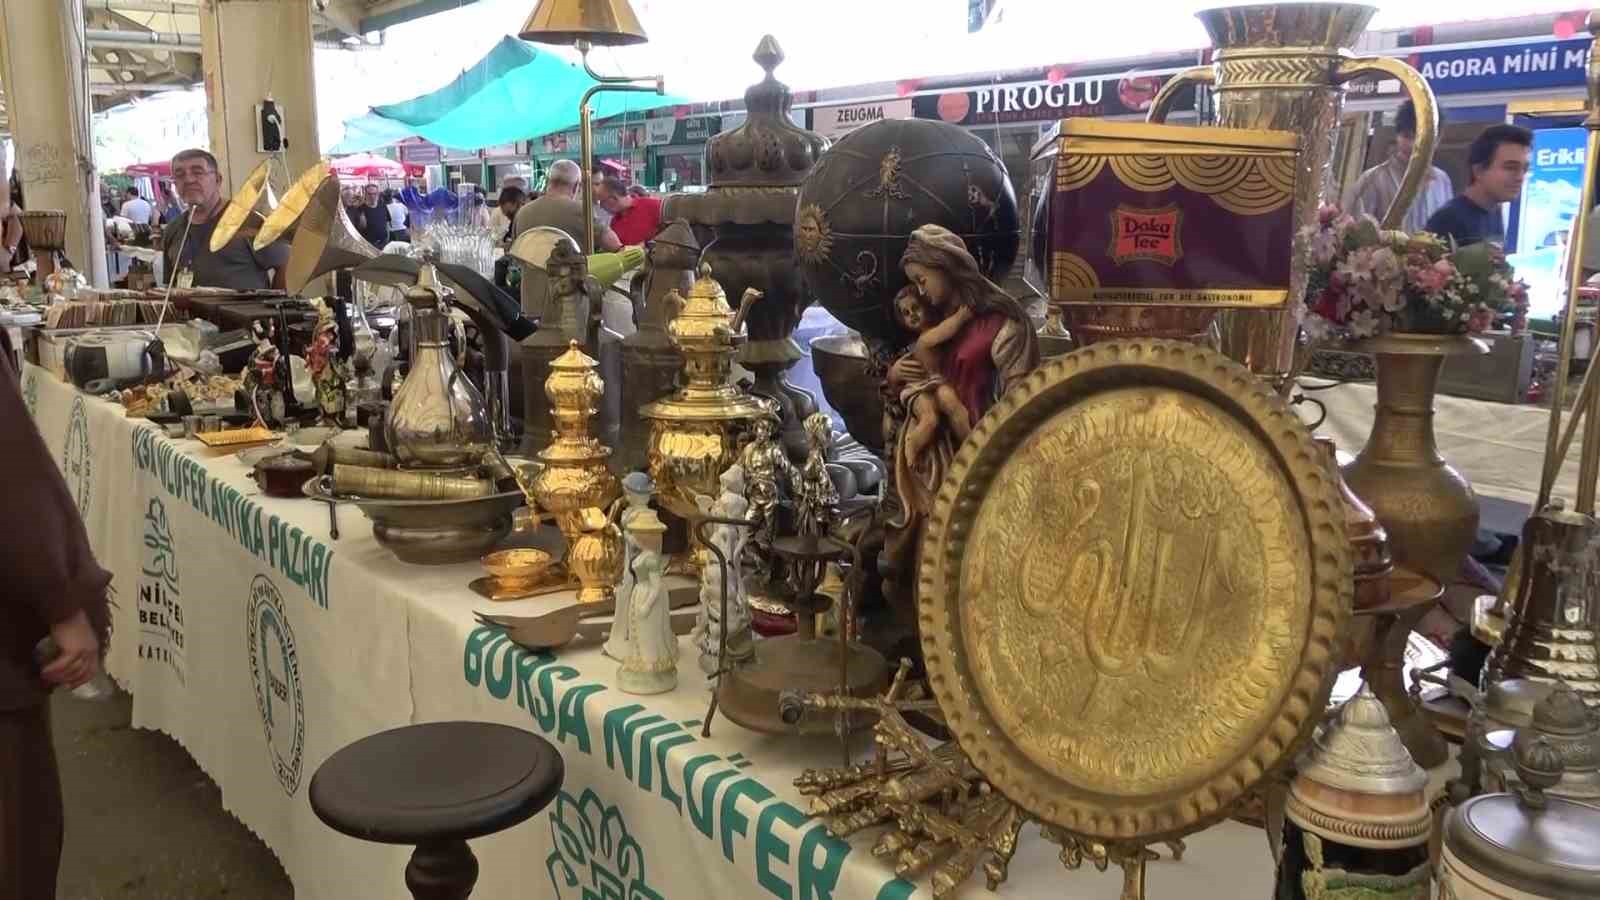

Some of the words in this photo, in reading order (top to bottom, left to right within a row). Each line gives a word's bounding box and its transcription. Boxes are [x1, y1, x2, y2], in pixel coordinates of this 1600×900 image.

[1421, 56, 1497, 80] AGORA
[1503, 46, 1558, 74] MİNİ
[836, 106, 885, 122] ZEUGMA
[268, 514, 335, 611] PAZARI
[464, 624, 608, 755] BURSA
[602, 703, 852, 900] NİLÜFER
